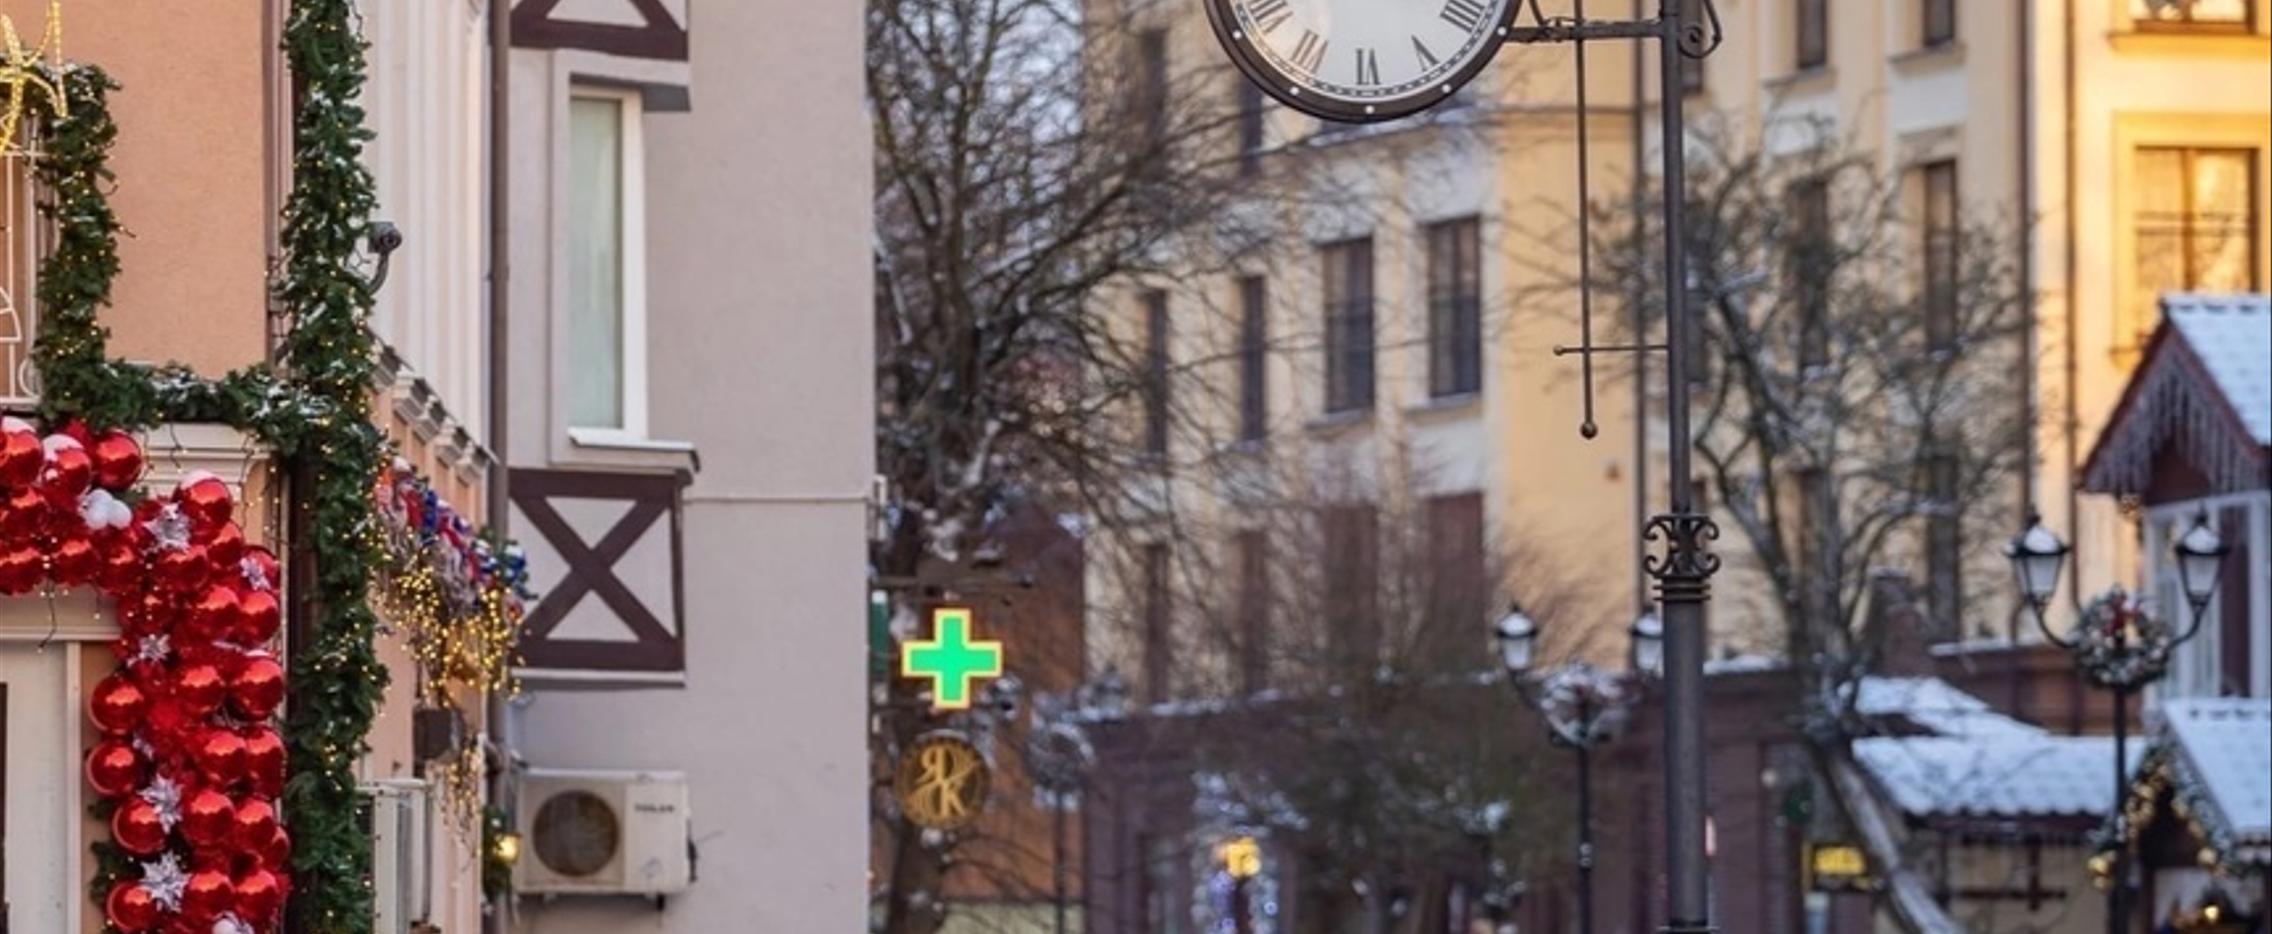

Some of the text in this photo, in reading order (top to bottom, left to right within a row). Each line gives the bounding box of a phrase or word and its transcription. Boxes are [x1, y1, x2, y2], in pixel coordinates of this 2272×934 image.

[1290, 28, 1329, 74] VII
[1355, 48, 1381, 85] VI
[1411, 34, 1440, 72] V
